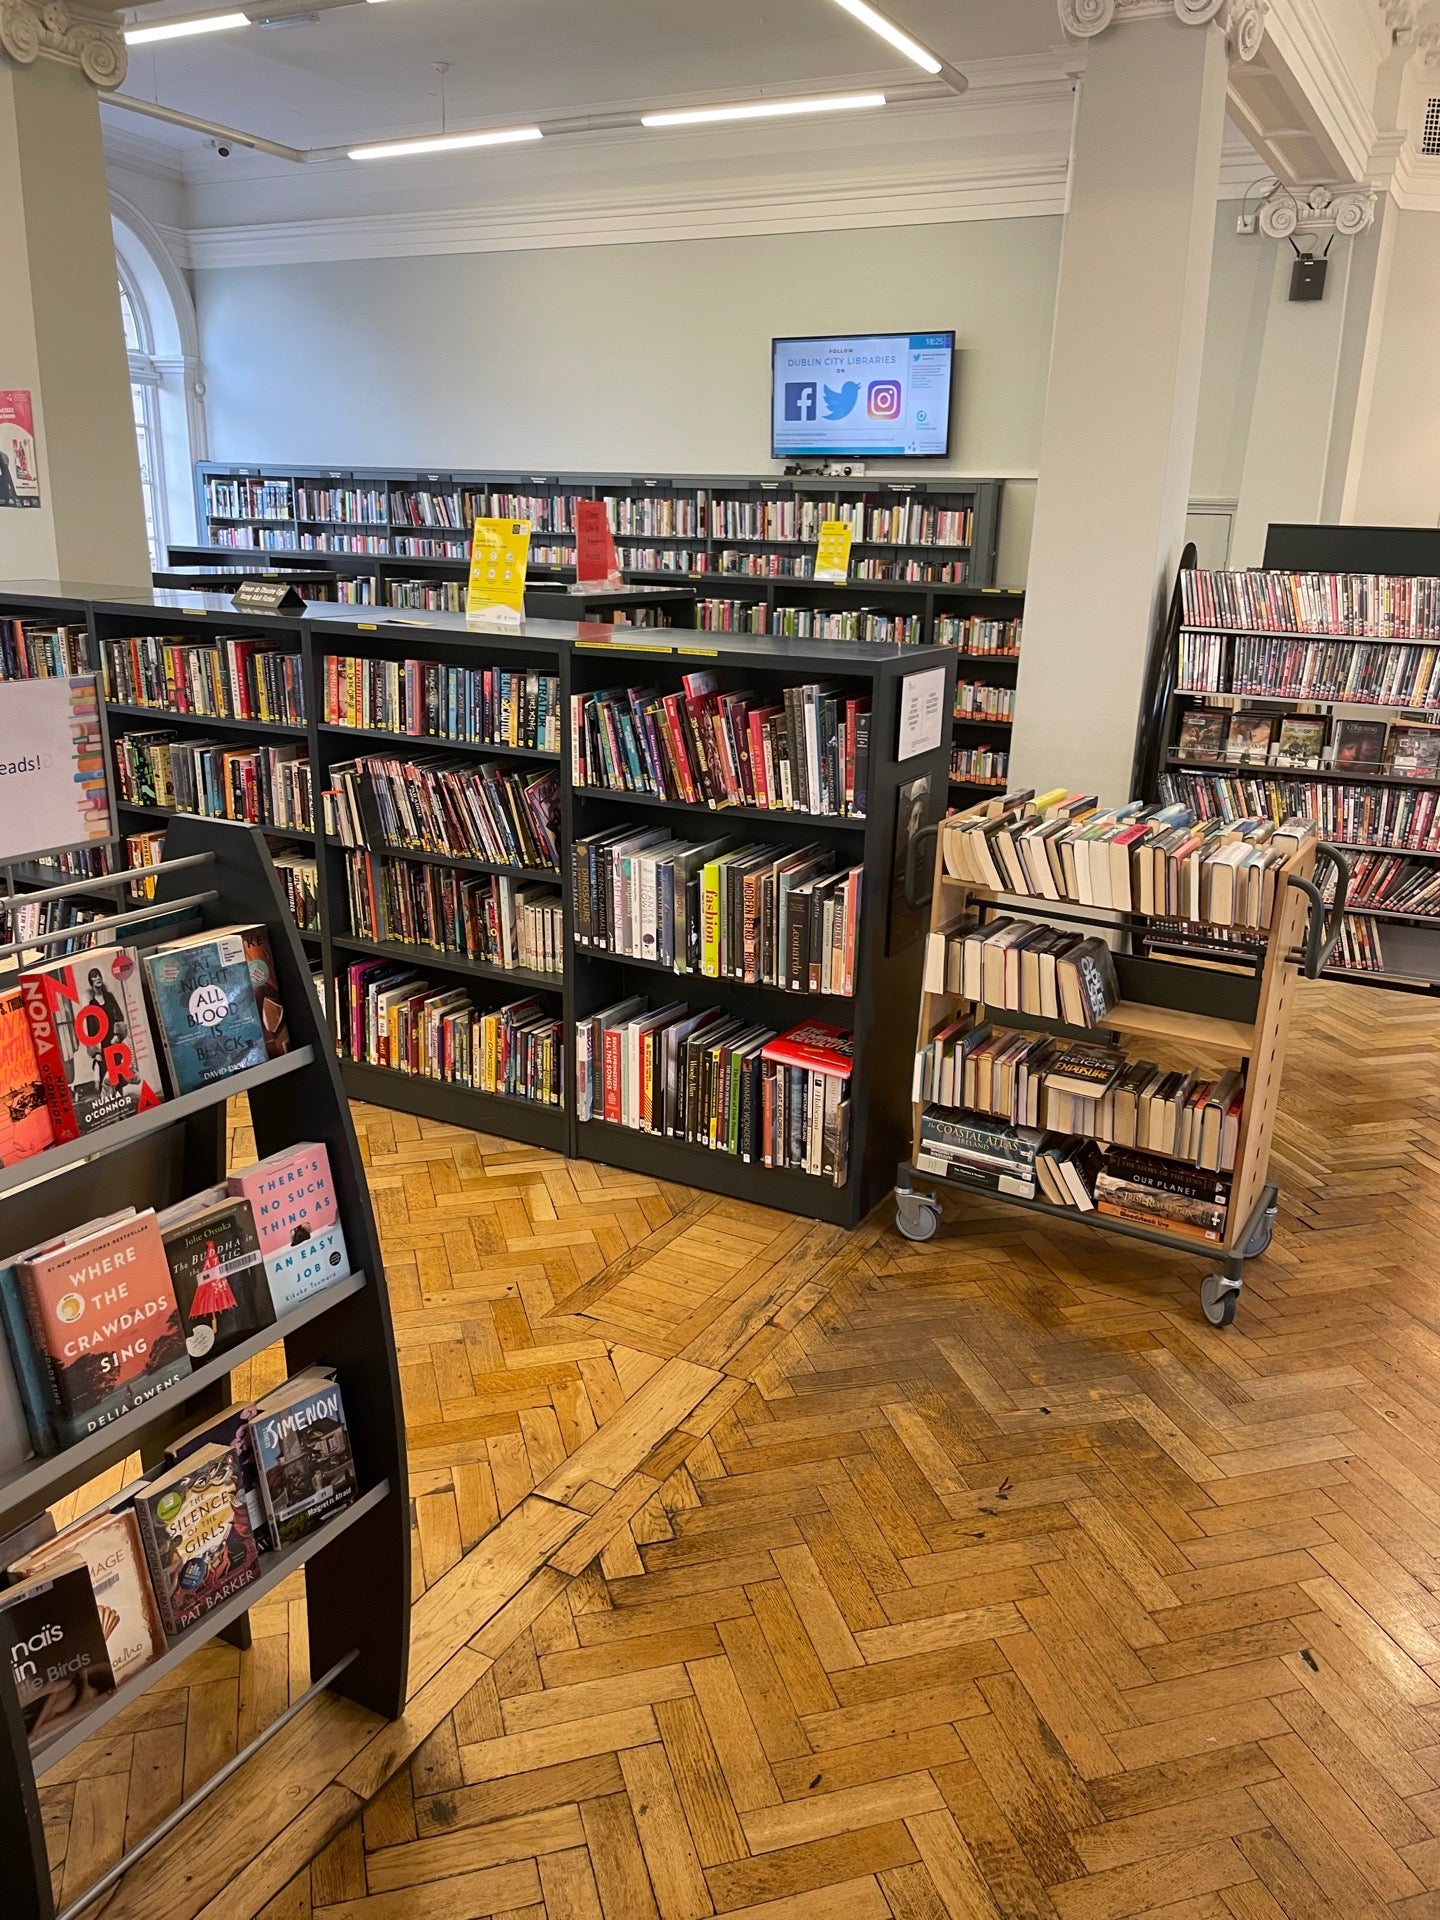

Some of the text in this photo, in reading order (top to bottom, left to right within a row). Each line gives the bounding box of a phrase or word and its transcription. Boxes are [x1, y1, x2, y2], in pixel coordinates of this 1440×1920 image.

[787, 355, 897, 367] DUBLIN CITY LIBRARIES
[501, 673, 510, 741] BLINK CAUTION
[538, 681, 547, 728] TRAITOR
[690, 717, 698, 728] 35
[1347, 725, 1378, 734] CONJURING
[650, 734, 659, 760] Mastering
[0, 755, 42, 776] eads!
[581, 868, 590, 923] DINOSAURS
[597, 868, 607, 934] SCIENCE ANIMALS
[641, 884, 649, 924] FLOWERS
[705, 889, 718, 944] fashion
[745, 882, 755, 974] MODERN RETRO HOME
[193, 955, 211, 972] AT
[792, 924, 804, 975] Leonardo
[180, 968, 229, 992] NIGHT
[196, 988, 224, 1008] ALL
[22, 981, 54, 1056] NORA
[186, 1002, 239, 1029] BLOOD
[44, 965, 161, 1114] NORA
[211, 1025, 223, 1039] IS
[786, 1035, 855, 1053] REVOLUTIO
[196, 1036, 244, 1061] BLACK
[1059, 1055, 1116, 1071] REICHS
[203, 1067, 228, 1081] DAVID
[689, 1060, 697, 1097] Woody Allen
[1054, 1062, 1111, 1080] EXPOSURE
[42, 1064, 62, 1125] O'CONNOR
[56, 1076, 69, 1114] NUALA
[85, 1096, 132, 1123] O'CONNOR
[91, 1090, 122, 1109] NUALA
[743, 1072, 751, 1147] MANMADE WONDERS
[814, 1093, 823, 1130] Holocaust
[936, 1123, 983, 1143] COASTAL
[986, 1135, 1019, 1151] ATLAS
[956, 1138, 990, 1151] IRELAND
[258, 1161, 319, 1195] THERE'S
[1132, 1174, 1197, 1196] OUR PLANET
[260, 1179, 325, 1216] NO SUCH
[1123, 1191, 1193, 1218] IRISH REVOLUTION
[261, 1208, 307, 1236] THING
[315, 1196, 331, 1212] AS
[1120, 1211, 1156, 1225] Woodstock
[56, 1224, 149, 1269] NEW YORK TIMES BESTSELLER
[184, 1234, 202, 1249] Julie
[203, 1221, 232, 1238] Otsuka
[68, 1246, 137, 1288] WHERE
[173, 1234, 253, 1275] The BUDDHA in
[189, 1267, 200, 1277] the
[203, 1247, 241, 1271] ATTIC
[274, 1235, 335, 1273] AN EASY
[285, 1272, 337, 1302] Kikuko Tsumura
[296, 1263, 322, 1283] JOB
[91, 1282, 129, 1310] THE
[63, 1295, 169, 1358] CRAWDADS
[100, 1337, 148, 1373] SING
[87, 1373, 181, 1433] DELIA OWENS
[266, 1393, 338, 1449] SIMENON
[169, 1490, 230, 1537] SILENCE
[189, 1493, 205, 1507] THE
[307, 1487, 352, 1517] Maigret is Afraid
[184, 1522, 226, 1555] GIRLS
[187, 1513, 218, 1537] OF THE
[180, 1569, 255, 1628] PAT BARKER
[11, 1623, 65, 1663] naïs
[112, 1642, 143, 1669] oelho
[12, 1659, 38, 1685] in
[46, 1652, 92, 1683] Birds
